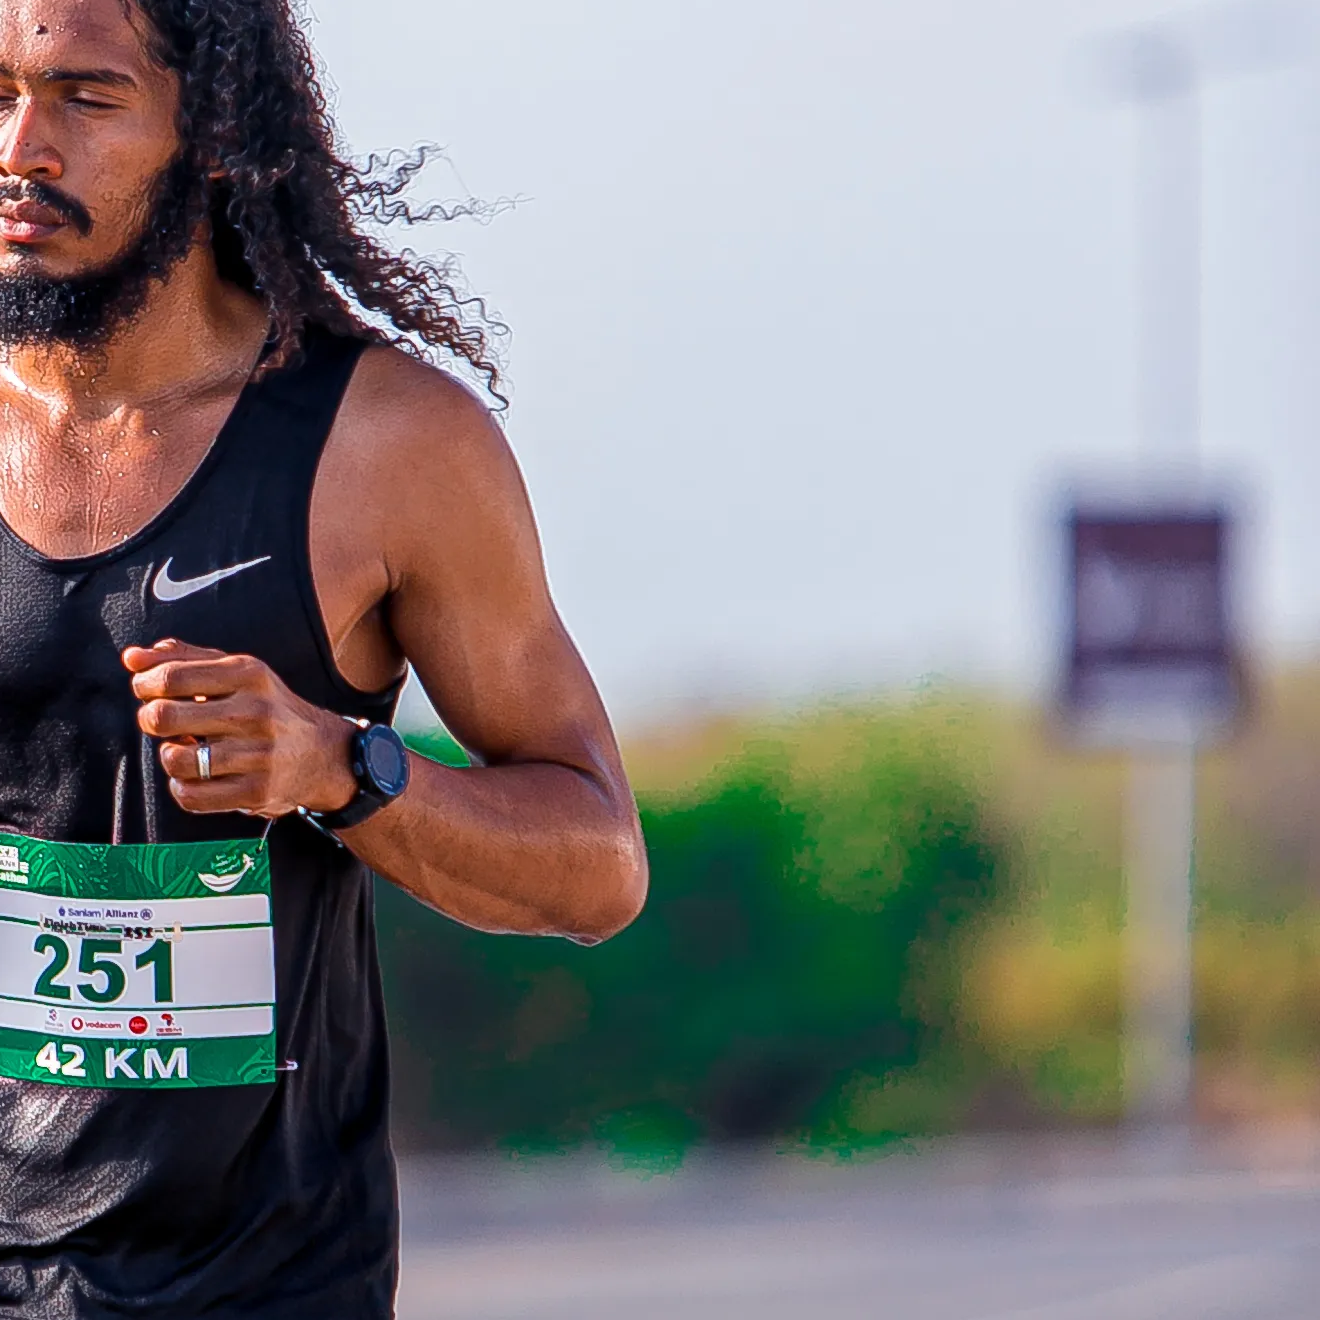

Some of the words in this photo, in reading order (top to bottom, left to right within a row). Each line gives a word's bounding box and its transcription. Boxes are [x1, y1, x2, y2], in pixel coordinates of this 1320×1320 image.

[68, 908, 101, 917] Sanlam
[105, 909, 138, 919] Allianz
[34, 933, 173, 1003] 251
[85, 1020, 122, 1029] vodacom
[36, 1041, 86, 1077] 42
[105, 1047, 188, 1079] KM
